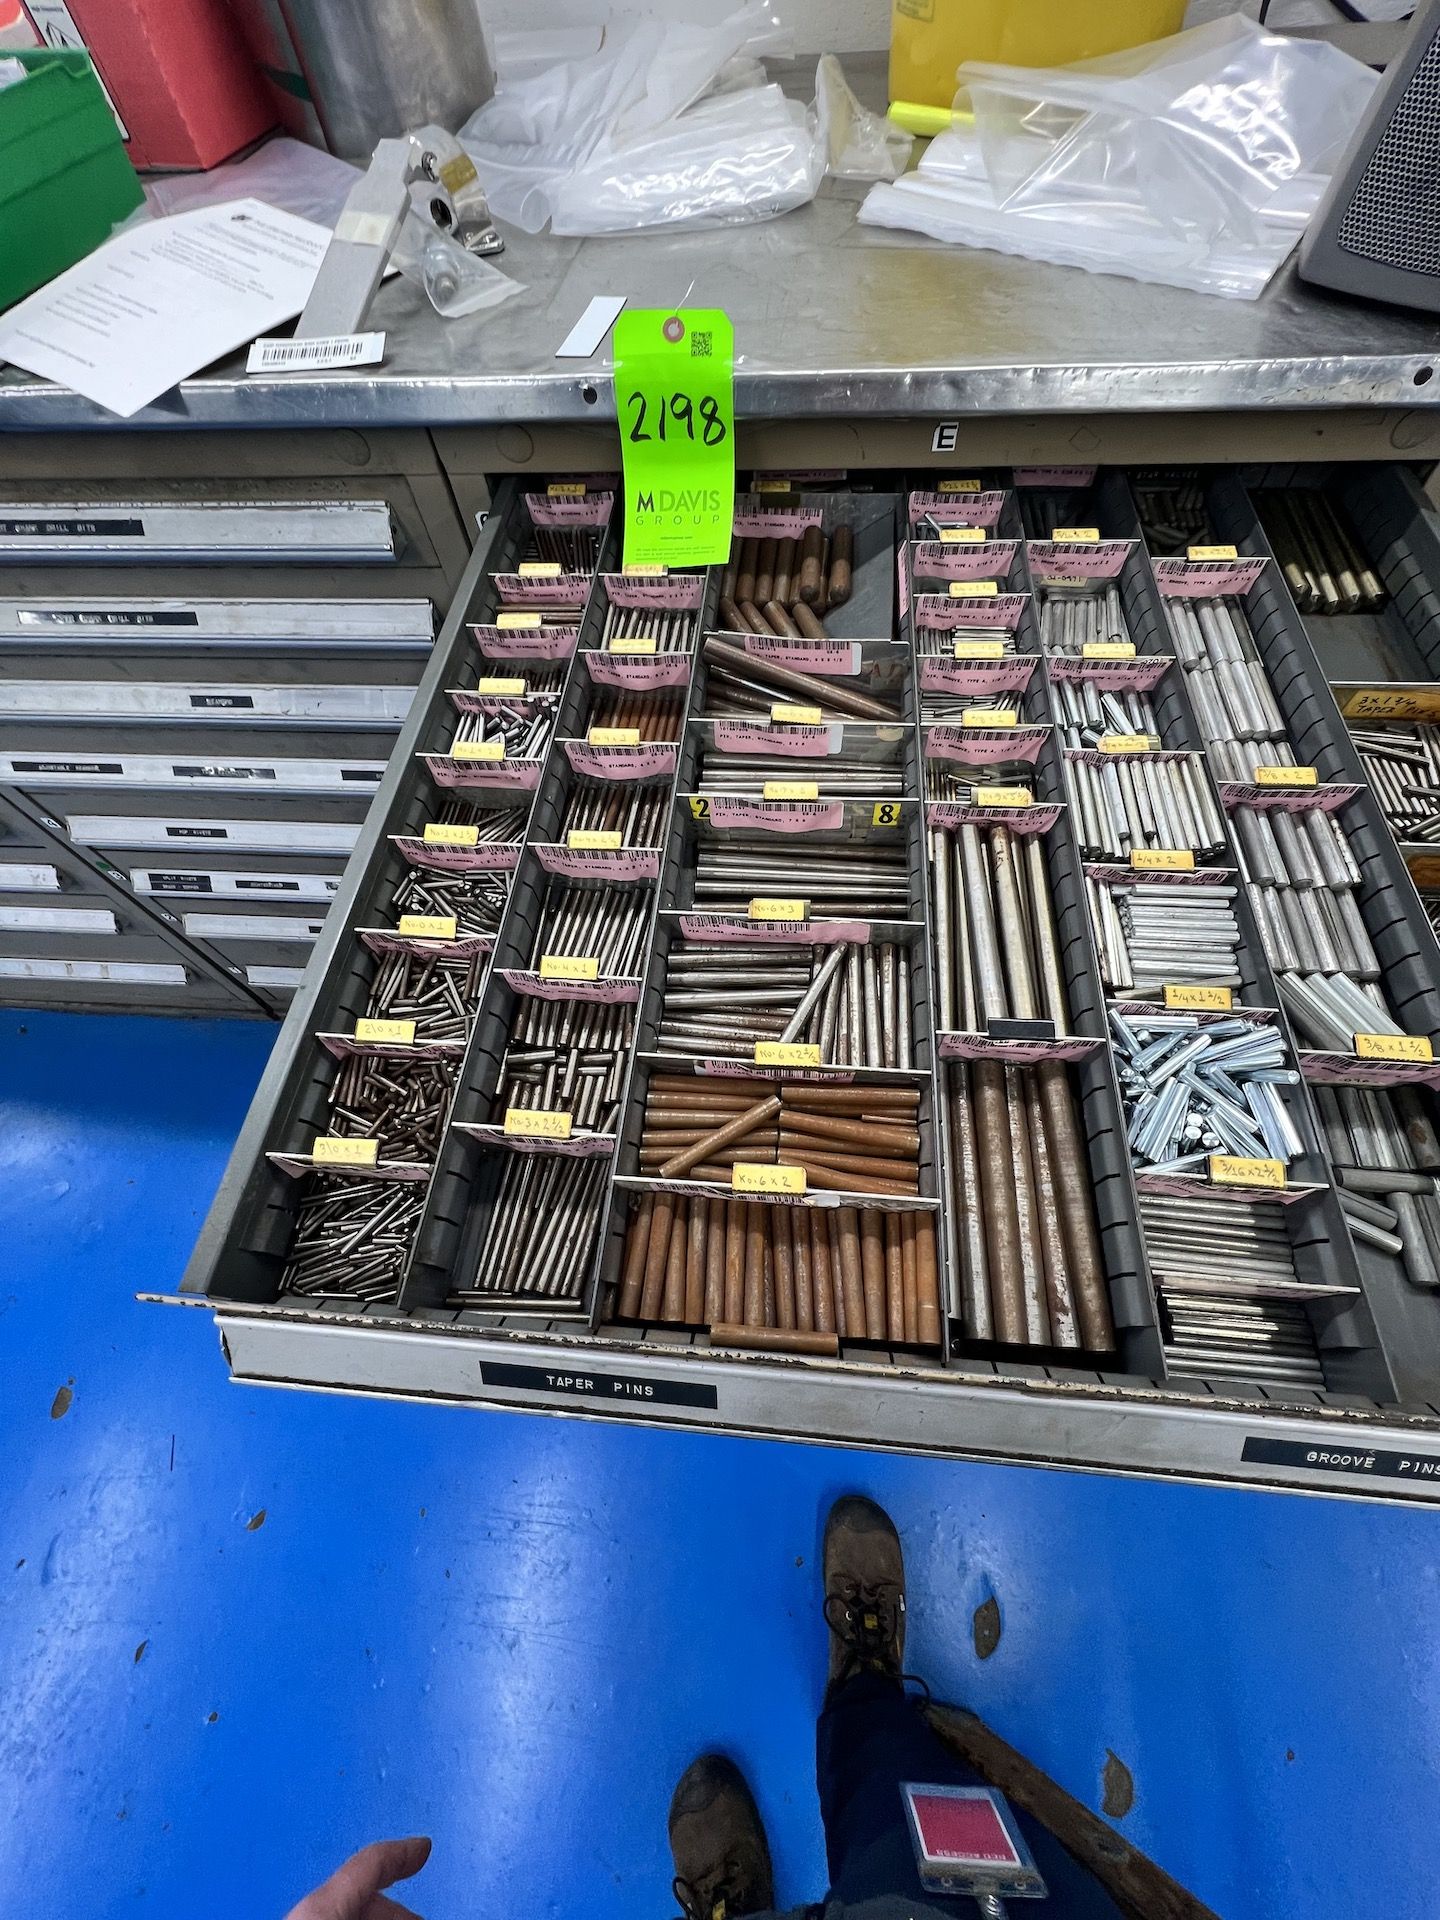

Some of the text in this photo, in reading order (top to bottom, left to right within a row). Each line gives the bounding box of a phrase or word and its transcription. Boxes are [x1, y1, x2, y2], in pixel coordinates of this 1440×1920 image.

[627, 391, 726, 447] 2198
[938, 426, 957, 449] E
[636, 515, 720, 526] GROUP
[696, 799, 710, 818] 2
[879, 805, 894, 823] 8
[1166, 856, 1176, 864] 2
[782, 1175, 793, 1187] 2
[546, 1375, 654, 1396] TAPER PINS
[1306, 1451, 1376, 1469] GROOVE
